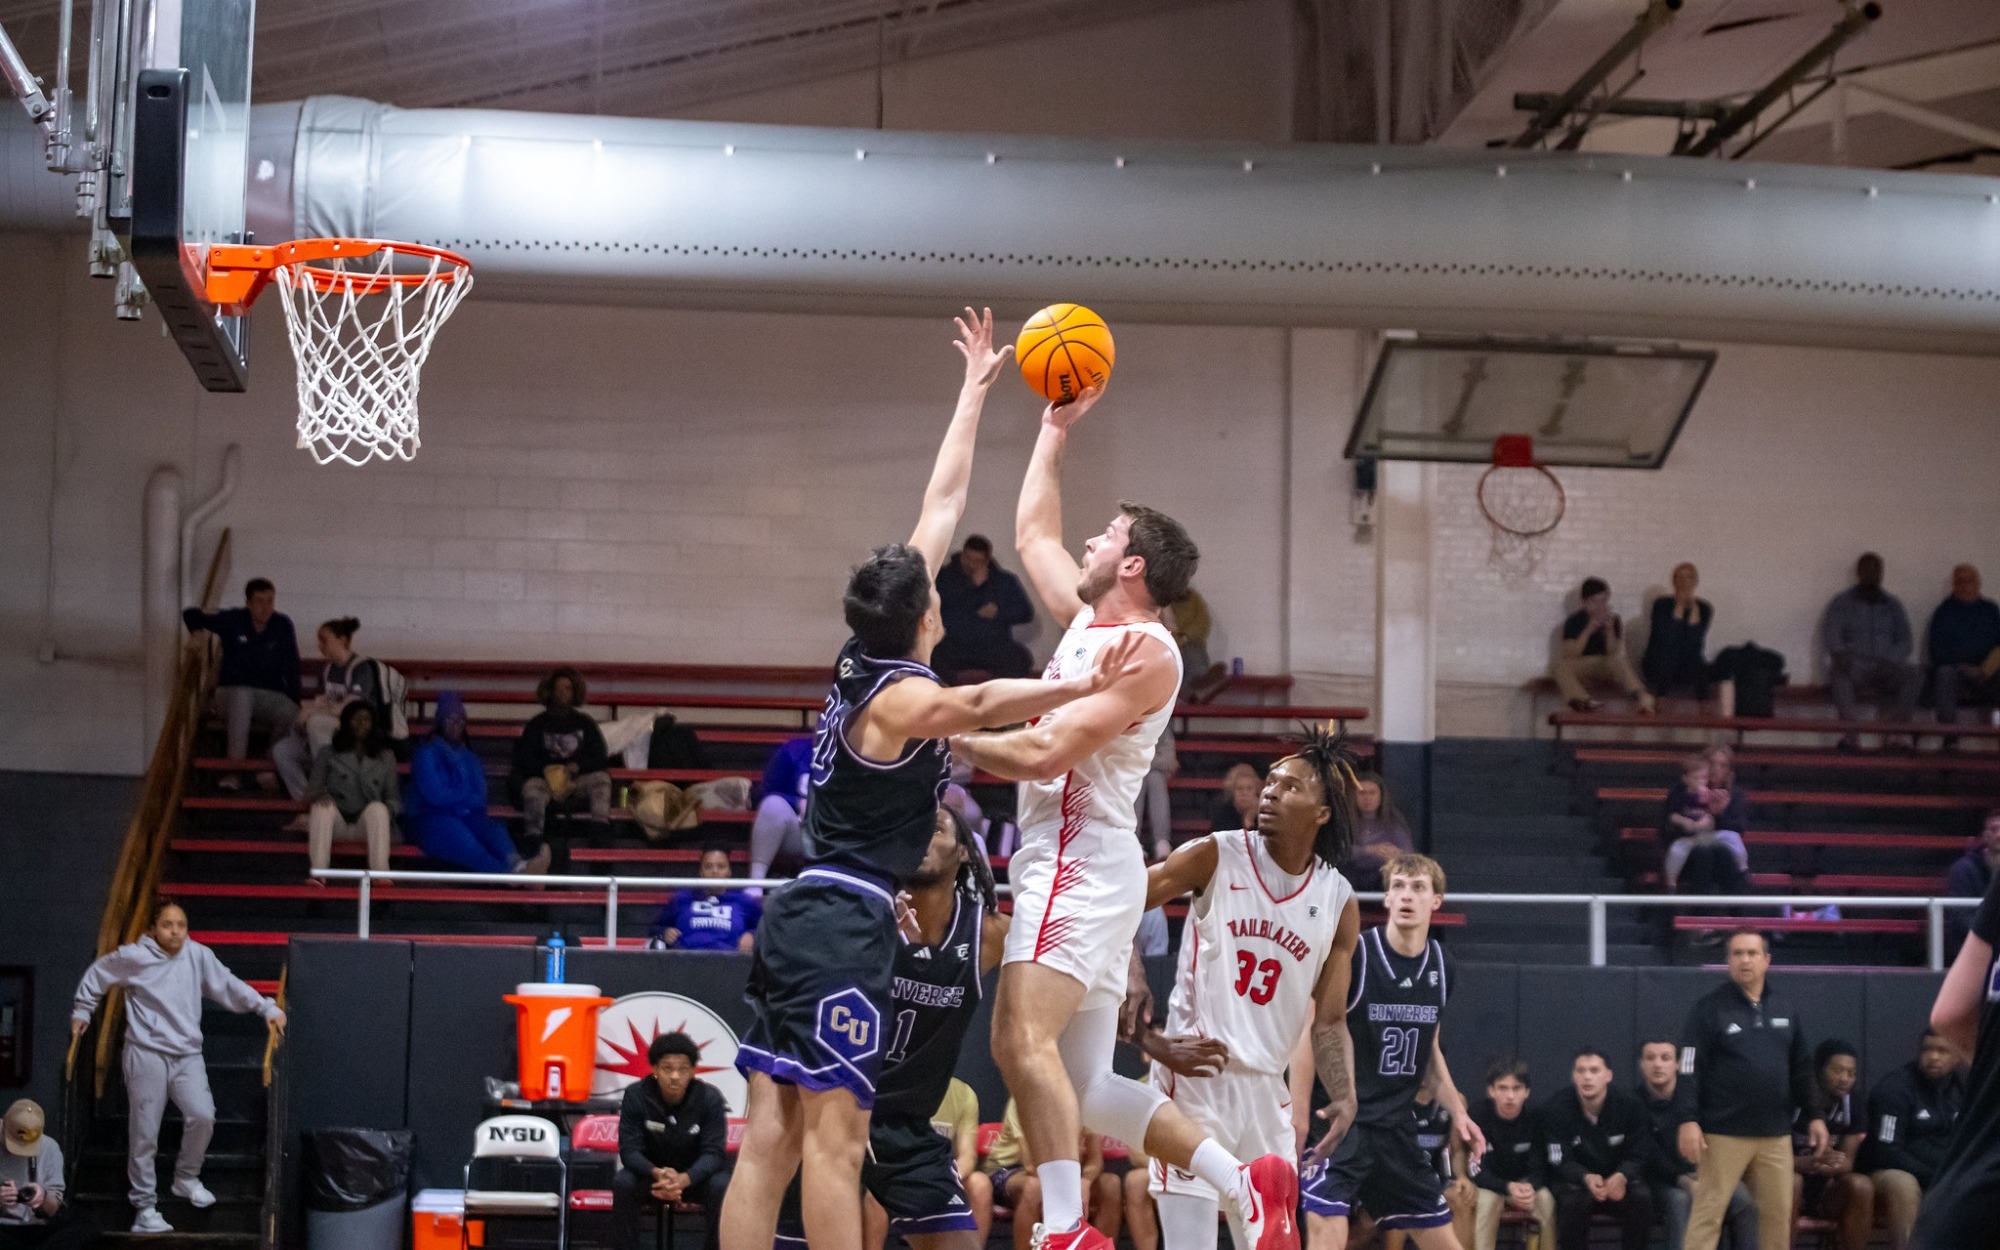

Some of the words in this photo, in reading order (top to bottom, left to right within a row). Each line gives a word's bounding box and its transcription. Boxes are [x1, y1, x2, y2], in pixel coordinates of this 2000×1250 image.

[891, 976, 965, 1008] NVERSE
[1235, 949, 1282, 1006] 33
[829, 1005, 870, 1046] CU
[1368, 1003, 1439, 1023] CONVERSE
[885, 1008, 917, 1063] 1
[1379, 1026, 1420, 1075] 21
[489, 1126, 546, 1142] NGU
